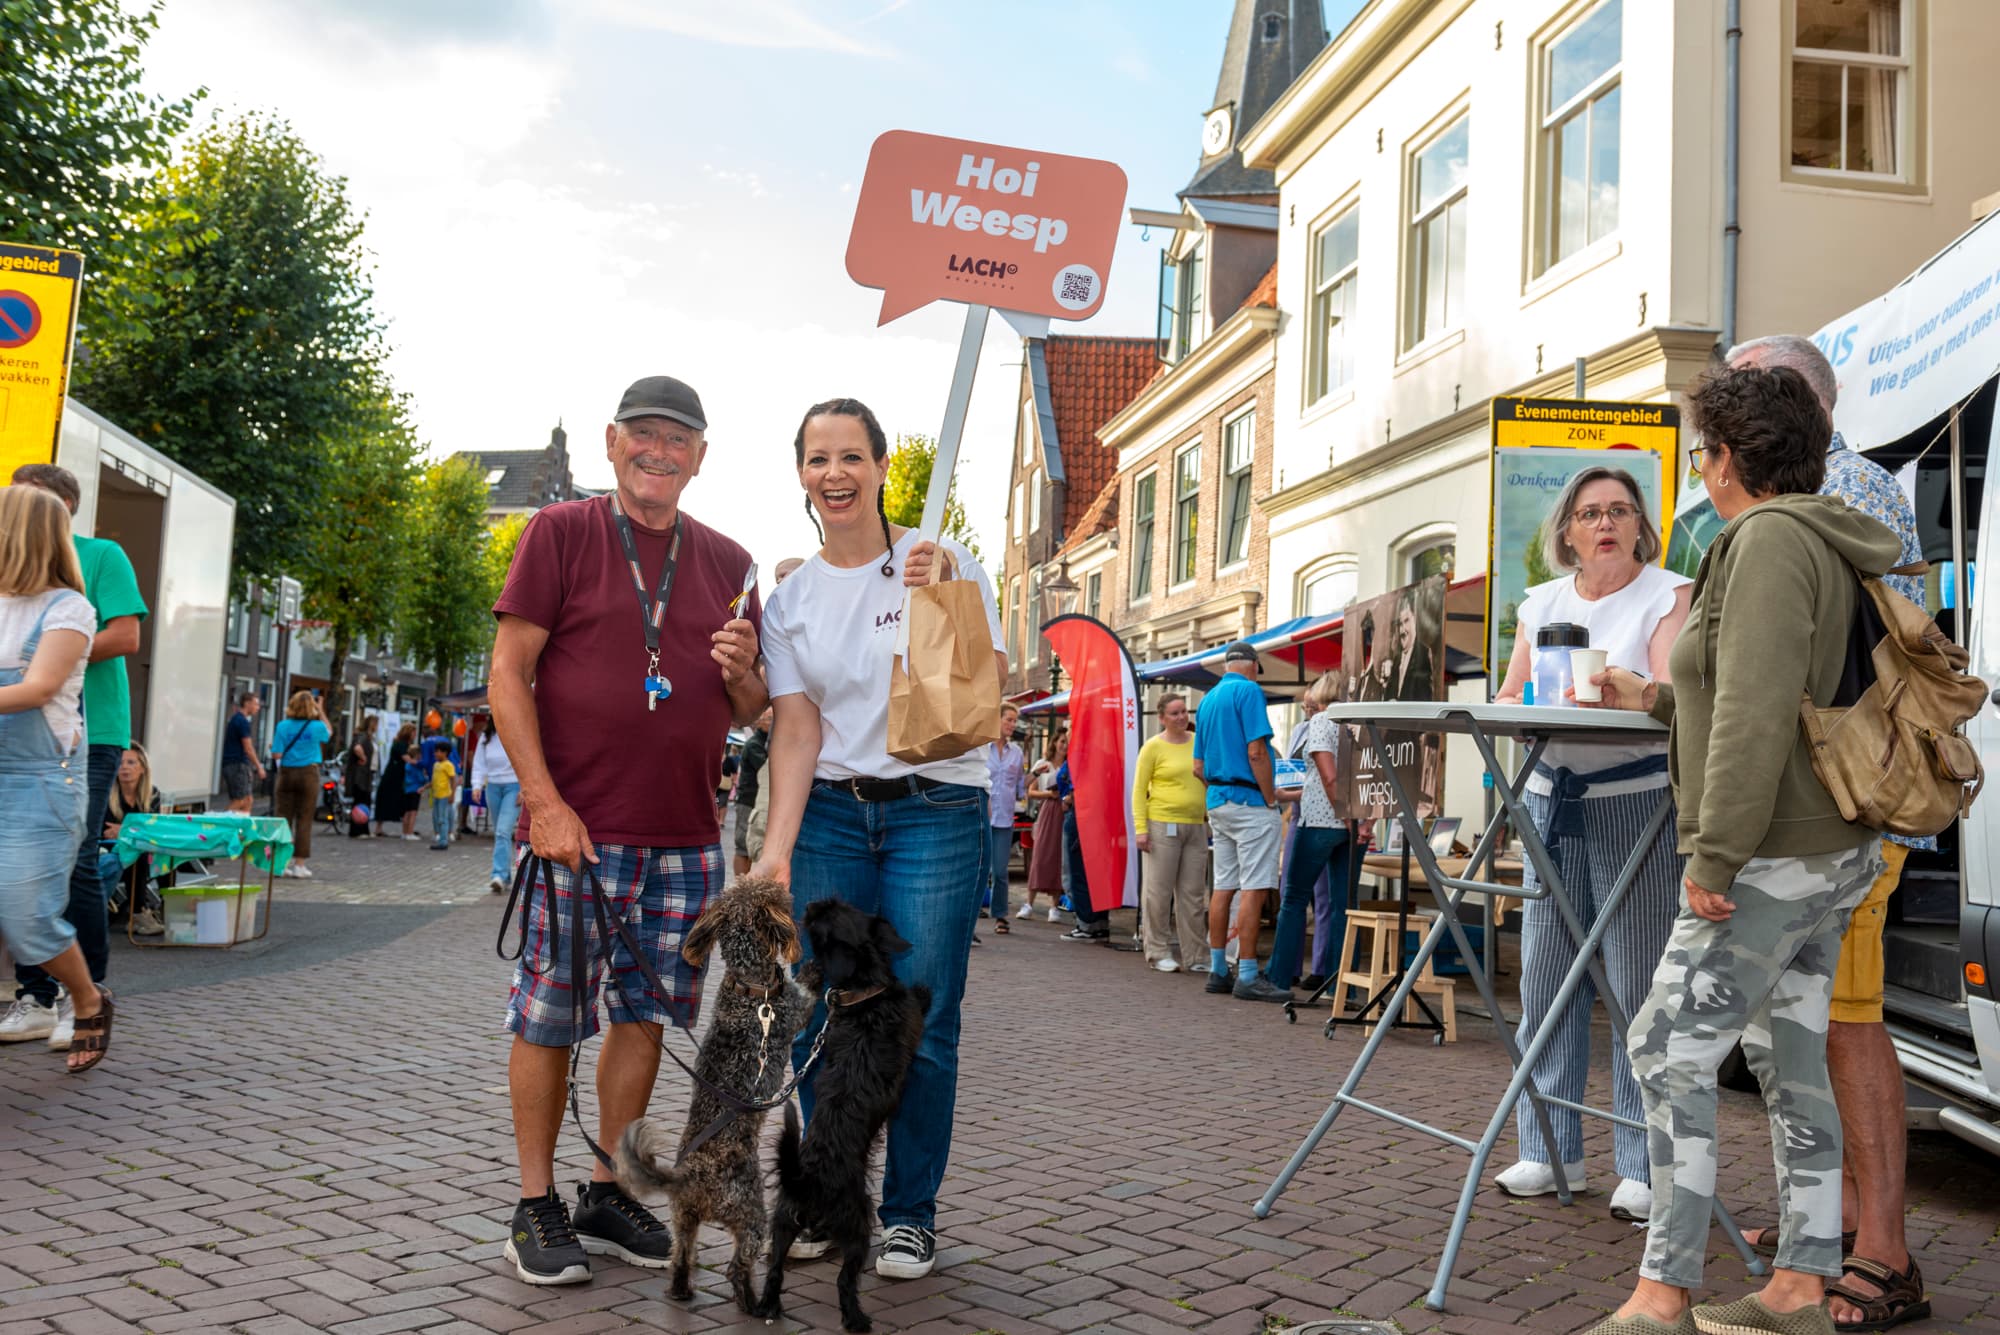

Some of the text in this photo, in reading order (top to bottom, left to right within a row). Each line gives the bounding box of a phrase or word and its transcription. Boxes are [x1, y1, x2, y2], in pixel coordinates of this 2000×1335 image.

[956, 153, 1040, 197] Hoi
[910, 188, 1069, 253] Weesp
[0, 255, 60, 273] gebied
[1868, 334, 1912, 365] Uitjes
[1915, 313, 1940, 344] voor
[1941, 275, 1993, 325] ouderen
[1869, 371, 1898, 396] Wie
[1899, 352, 1929, 390] gaat
[1930, 344, 1944, 367] er
[1945, 322, 1969, 357] met
[1971, 308, 1993, 337] ons
[1515, 404, 1662, 425] Evenementengebied
[1567, 427, 1606, 441] ZONE
[1507, 472, 1569, 489] Denkend
